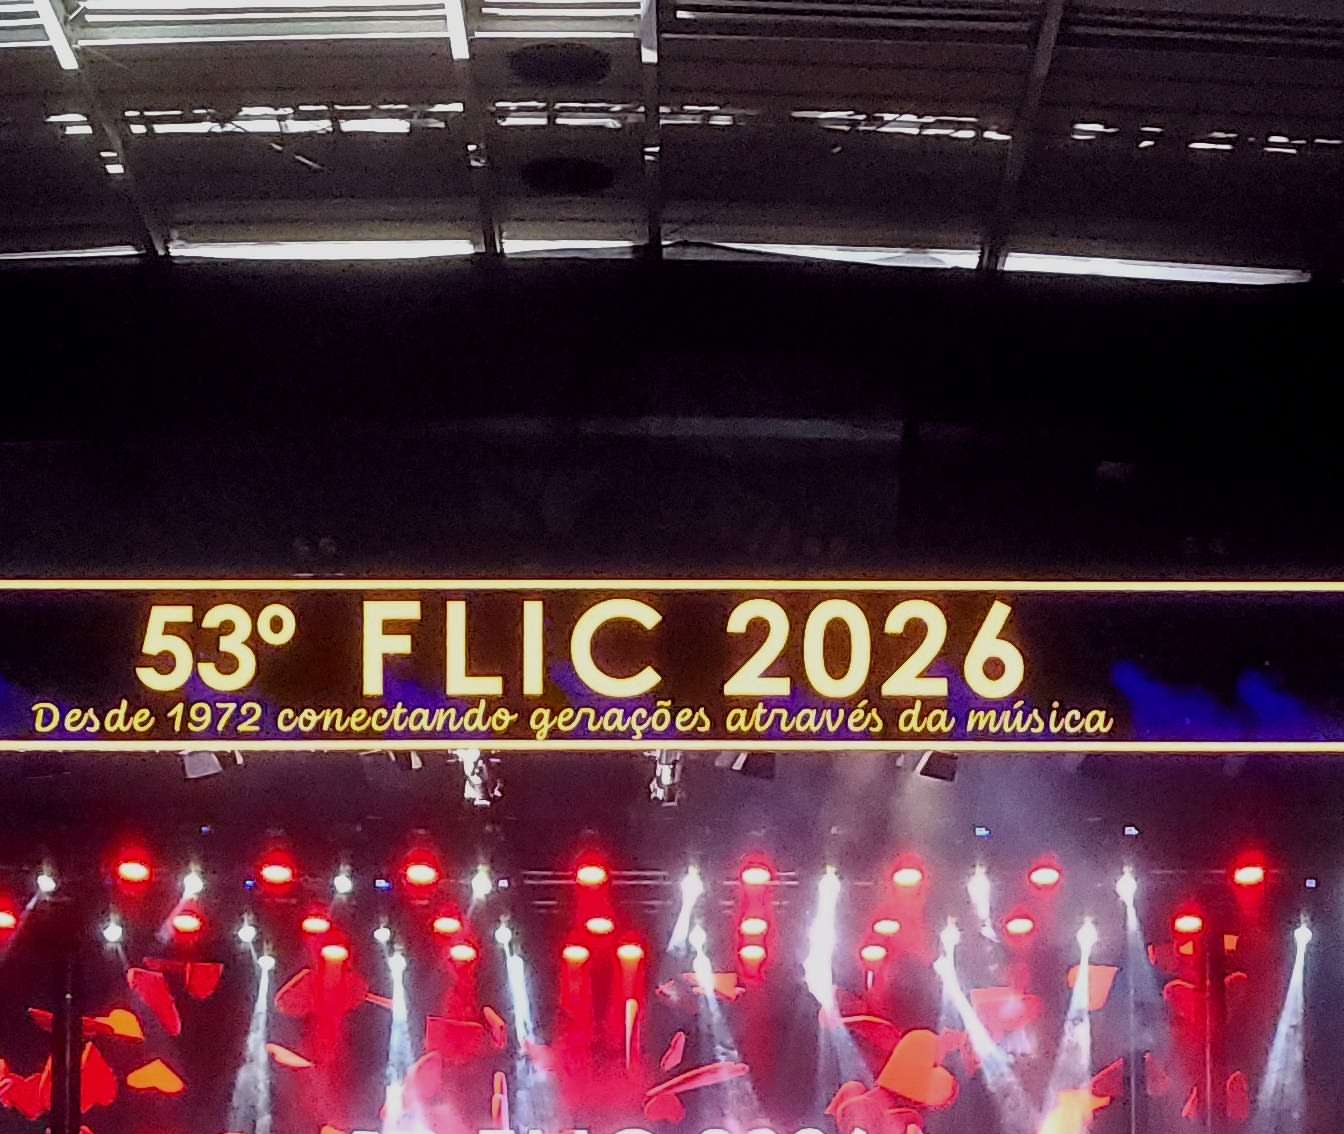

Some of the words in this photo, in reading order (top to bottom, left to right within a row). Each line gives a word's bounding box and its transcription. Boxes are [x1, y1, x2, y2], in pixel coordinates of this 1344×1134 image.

[135, 603, 296, 692] 53º
[362, 598, 663, 698] FLIC
[724, 598, 1025, 699] 2026
[31, 699, 155, 733] Desde
[166, 702, 263, 733] 1972
[276, 699, 518, 733] conectando
[528, 699, 711, 740] gerações
[726, 699, 884, 733] através
[898, 699, 955, 733] da
[966, 700, 1114, 733] música
